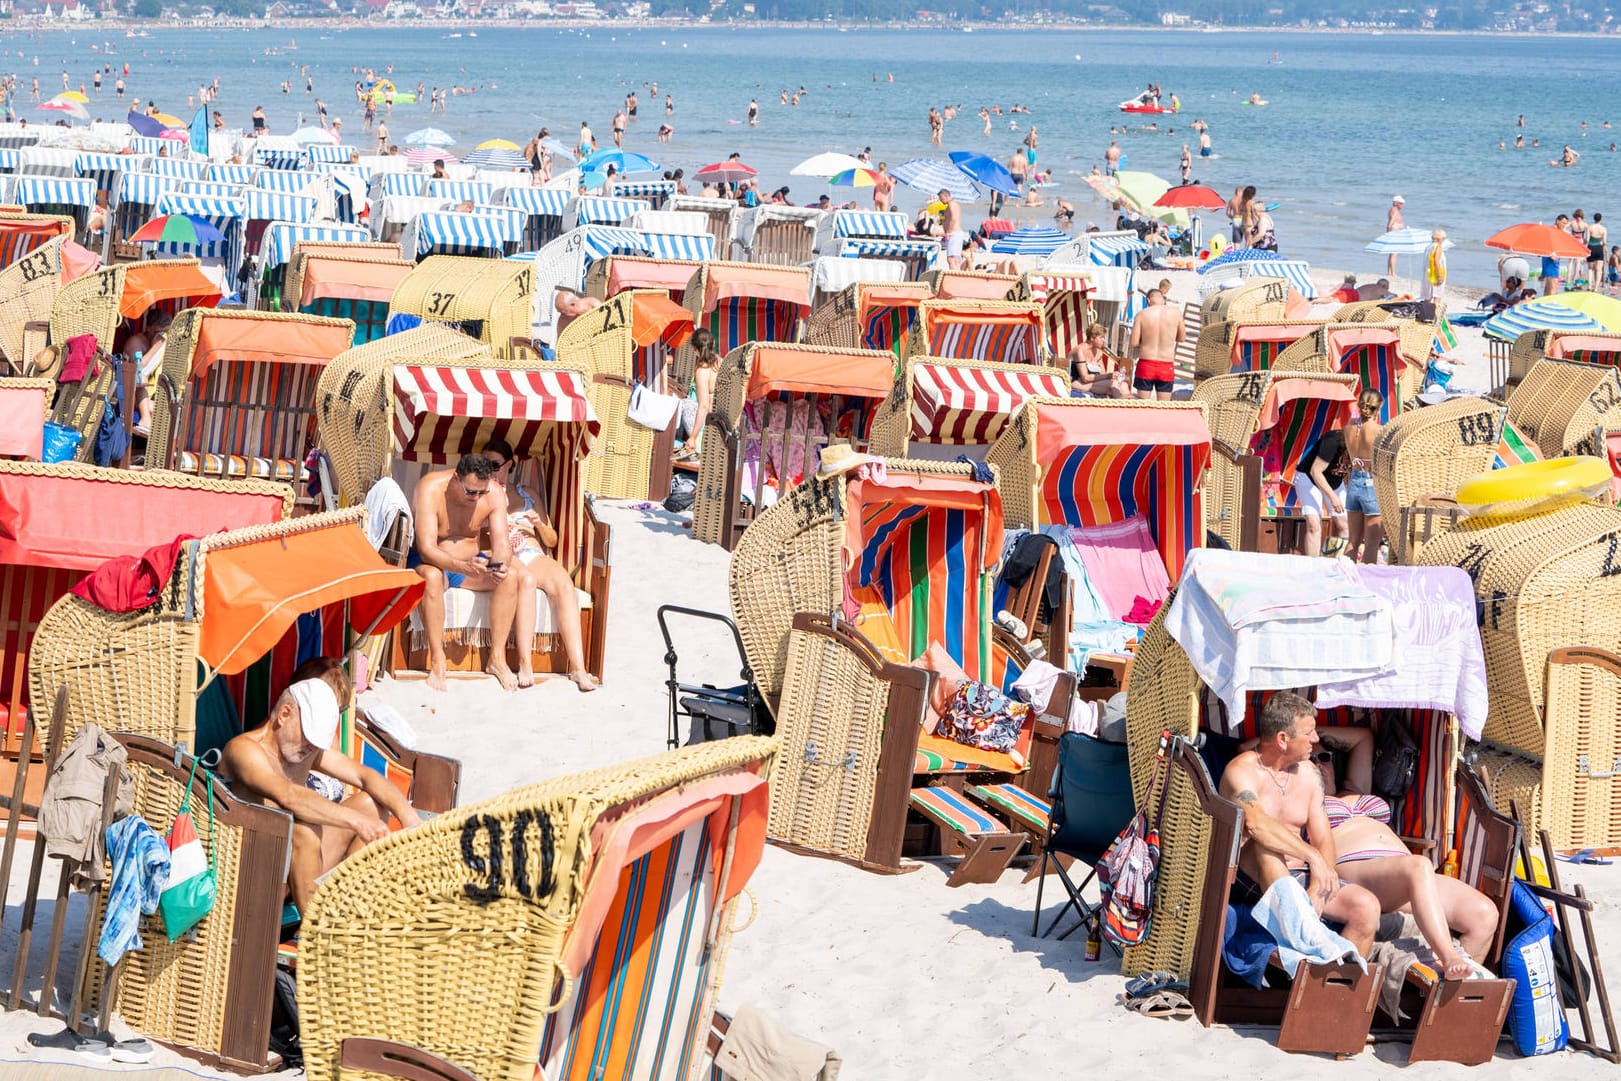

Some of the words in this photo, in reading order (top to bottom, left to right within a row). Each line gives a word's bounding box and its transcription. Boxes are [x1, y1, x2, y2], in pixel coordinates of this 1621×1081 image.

[564, 233, 582, 254] 49
[20, 251, 51, 282] 83
[98, 268, 117, 296] 31
[1262, 282, 1284, 303] 20
[428, 291, 455, 316] 37
[599, 299, 626, 332] 21
[1237, 372, 1261, 399] 26
[1458, 411, 1494, 445] 89
[460, 808, 557, 906] 90
